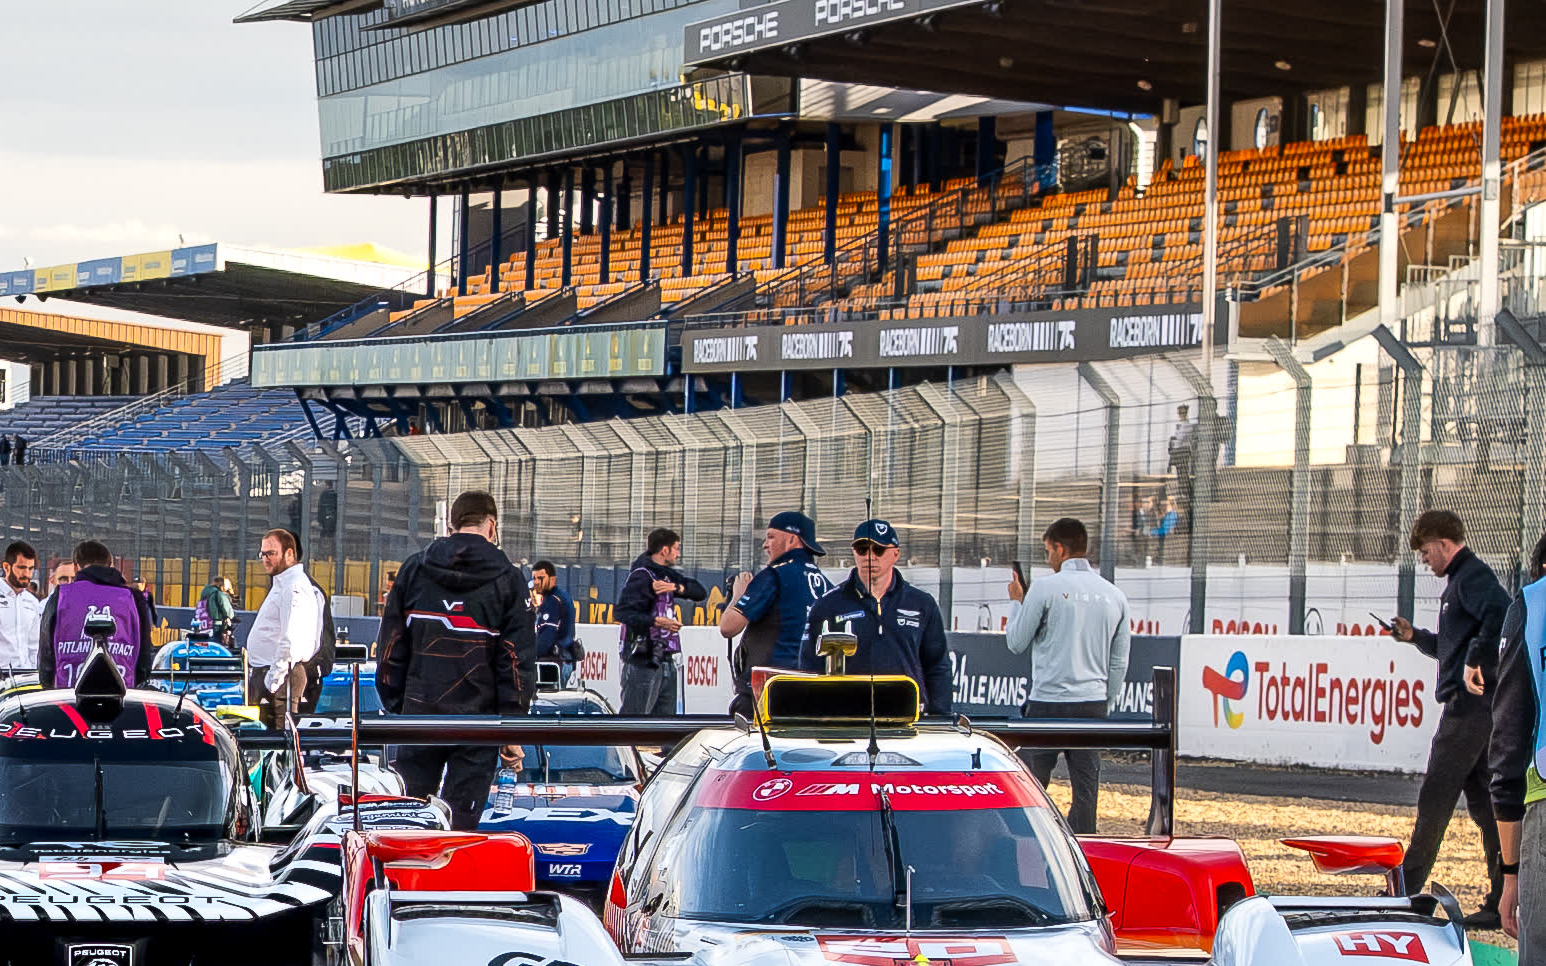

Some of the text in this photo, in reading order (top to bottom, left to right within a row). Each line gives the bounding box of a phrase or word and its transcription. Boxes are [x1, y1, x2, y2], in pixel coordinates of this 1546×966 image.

[700, 11, 779, 53] PORSCHE
[57, 641, 91, 653] PITLAN
[580, 652, 608, 681] BOSCH
[687, 655, 718, 687] BOSCH
[971, 675, 986, 703] LE
[988, 677, 1028, 706] MANS
[1255, 660, 1425, 745] TotalEnergies
[871, 782, 1004, 797] Motorsport
[549, 863, 582, 875] WTR
[73, 949, 127, 958] PEUGEOT
[1341, 933, 1415, 959] HY
